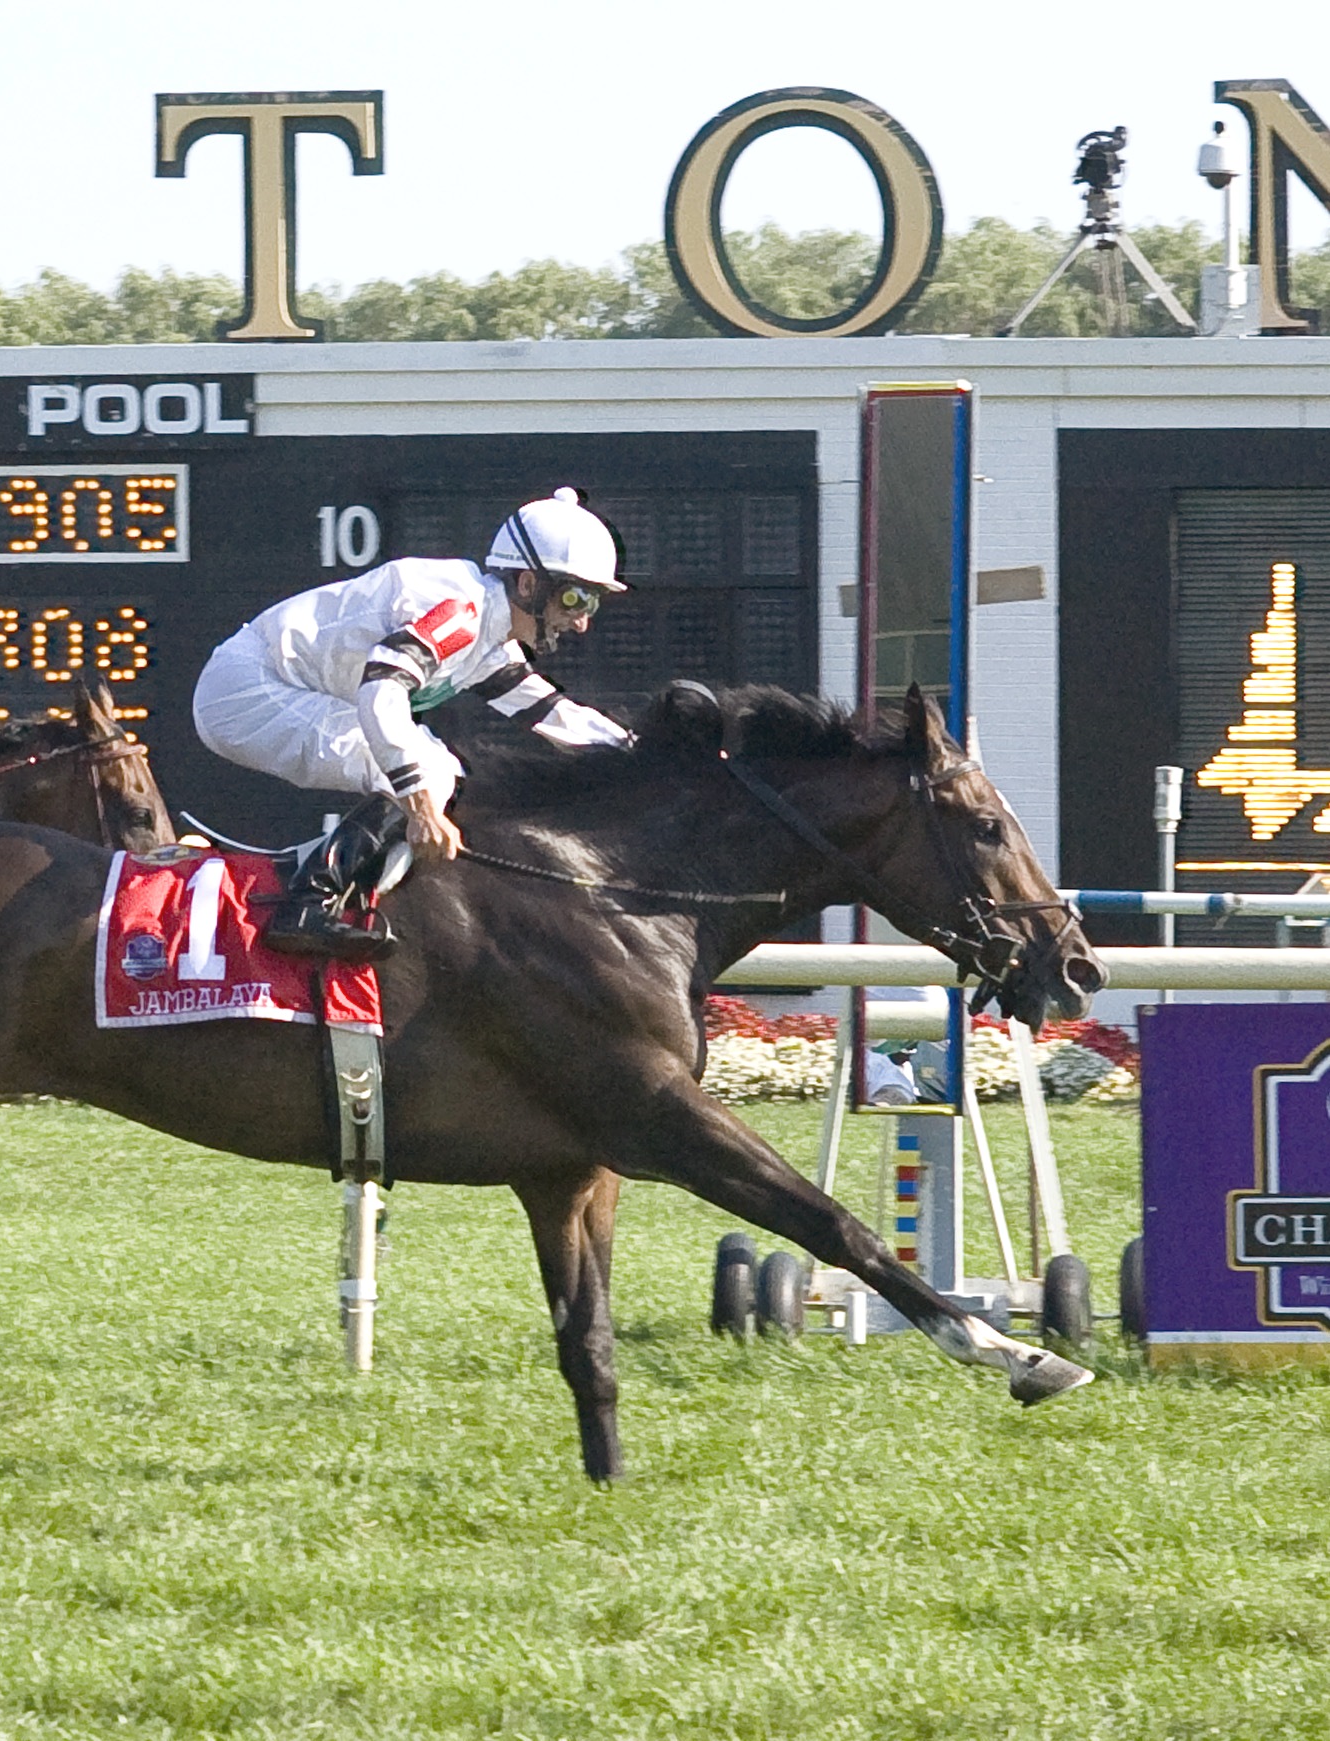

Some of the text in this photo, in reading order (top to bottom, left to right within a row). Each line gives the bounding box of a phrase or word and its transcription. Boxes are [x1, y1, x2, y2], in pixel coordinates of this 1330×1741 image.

[27, 382, 249, 437] POOL
[315, 505, 381, 568] 10
[177, 857, 227, 981] 1
[128, 981, 278, 1016] JAMBALAYA
[1253, 1213, 1330, 1246] CH
